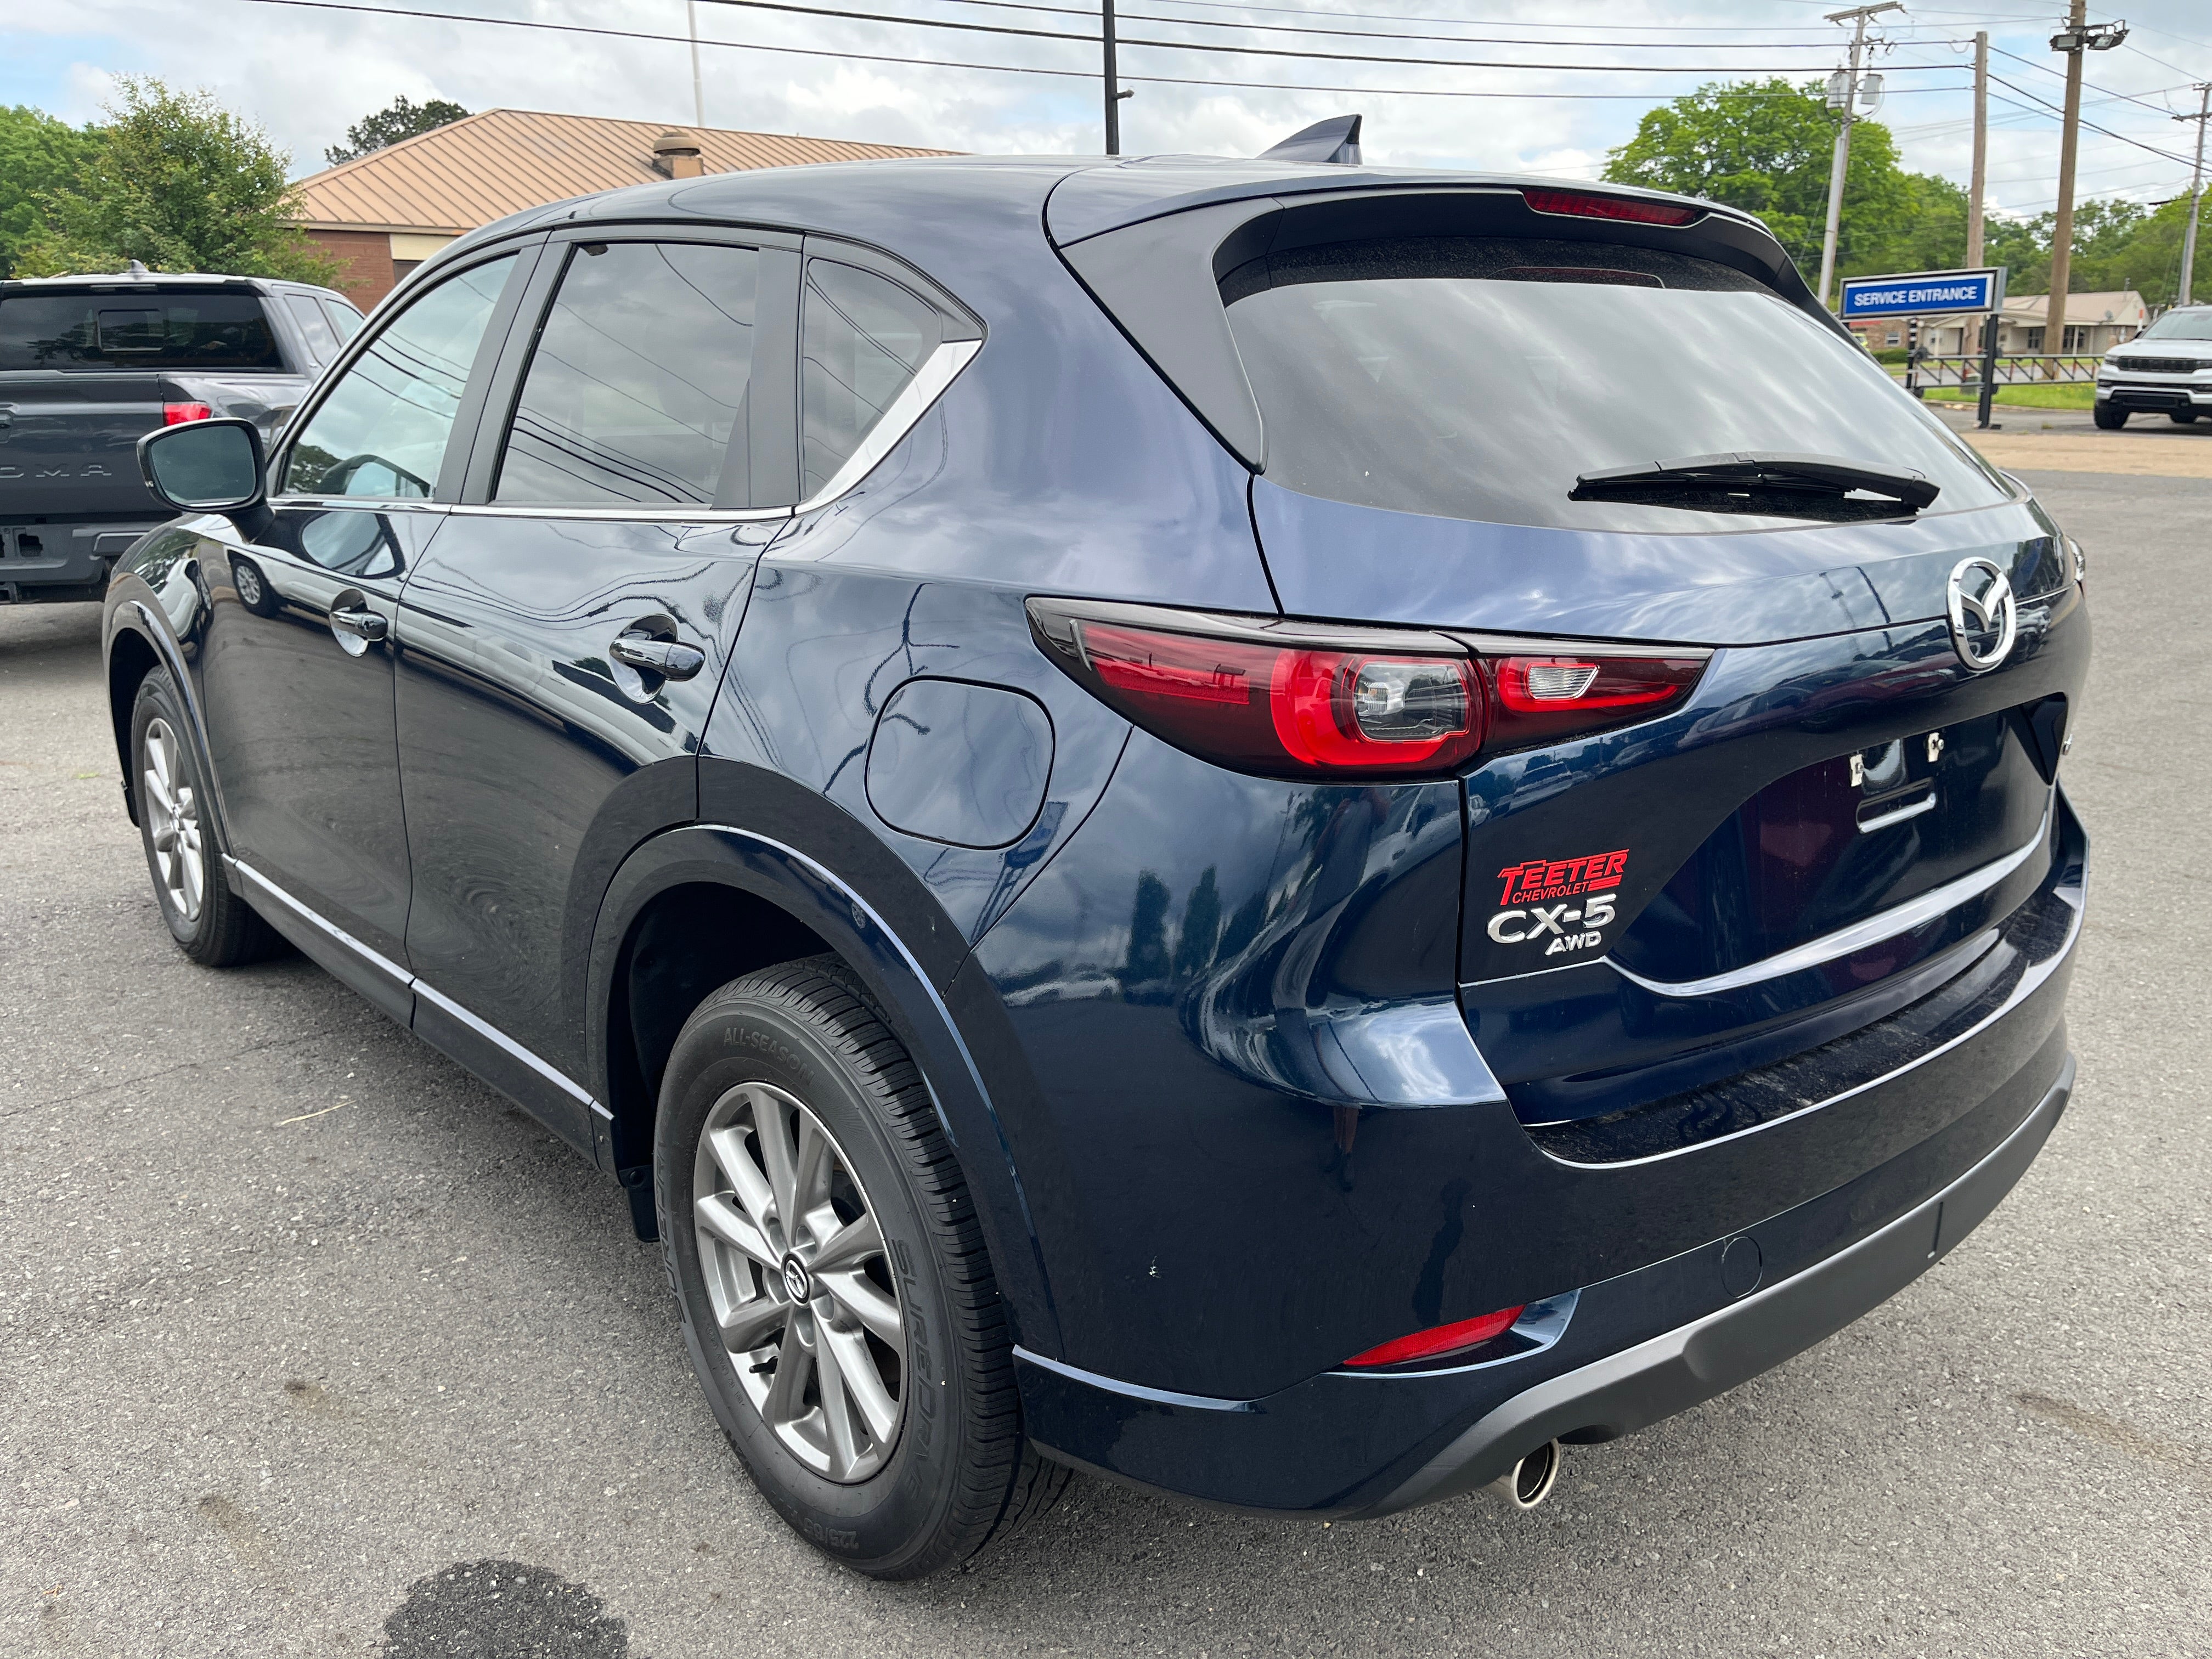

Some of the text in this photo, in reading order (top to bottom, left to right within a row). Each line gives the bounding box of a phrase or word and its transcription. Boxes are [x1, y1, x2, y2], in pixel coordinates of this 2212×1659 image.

[1854, 286, 1977, 307] SERVICE ENTRANCE
[1497, 849, 1629, 905] TEETER
[1511, 882, 1590, 904] CHEVROLET
[1486, 893, 1617, 944] CX-5
[1544, 930, 1602, 956] AWD
[723, 1028, 815, 1086] ALL-SEASON
